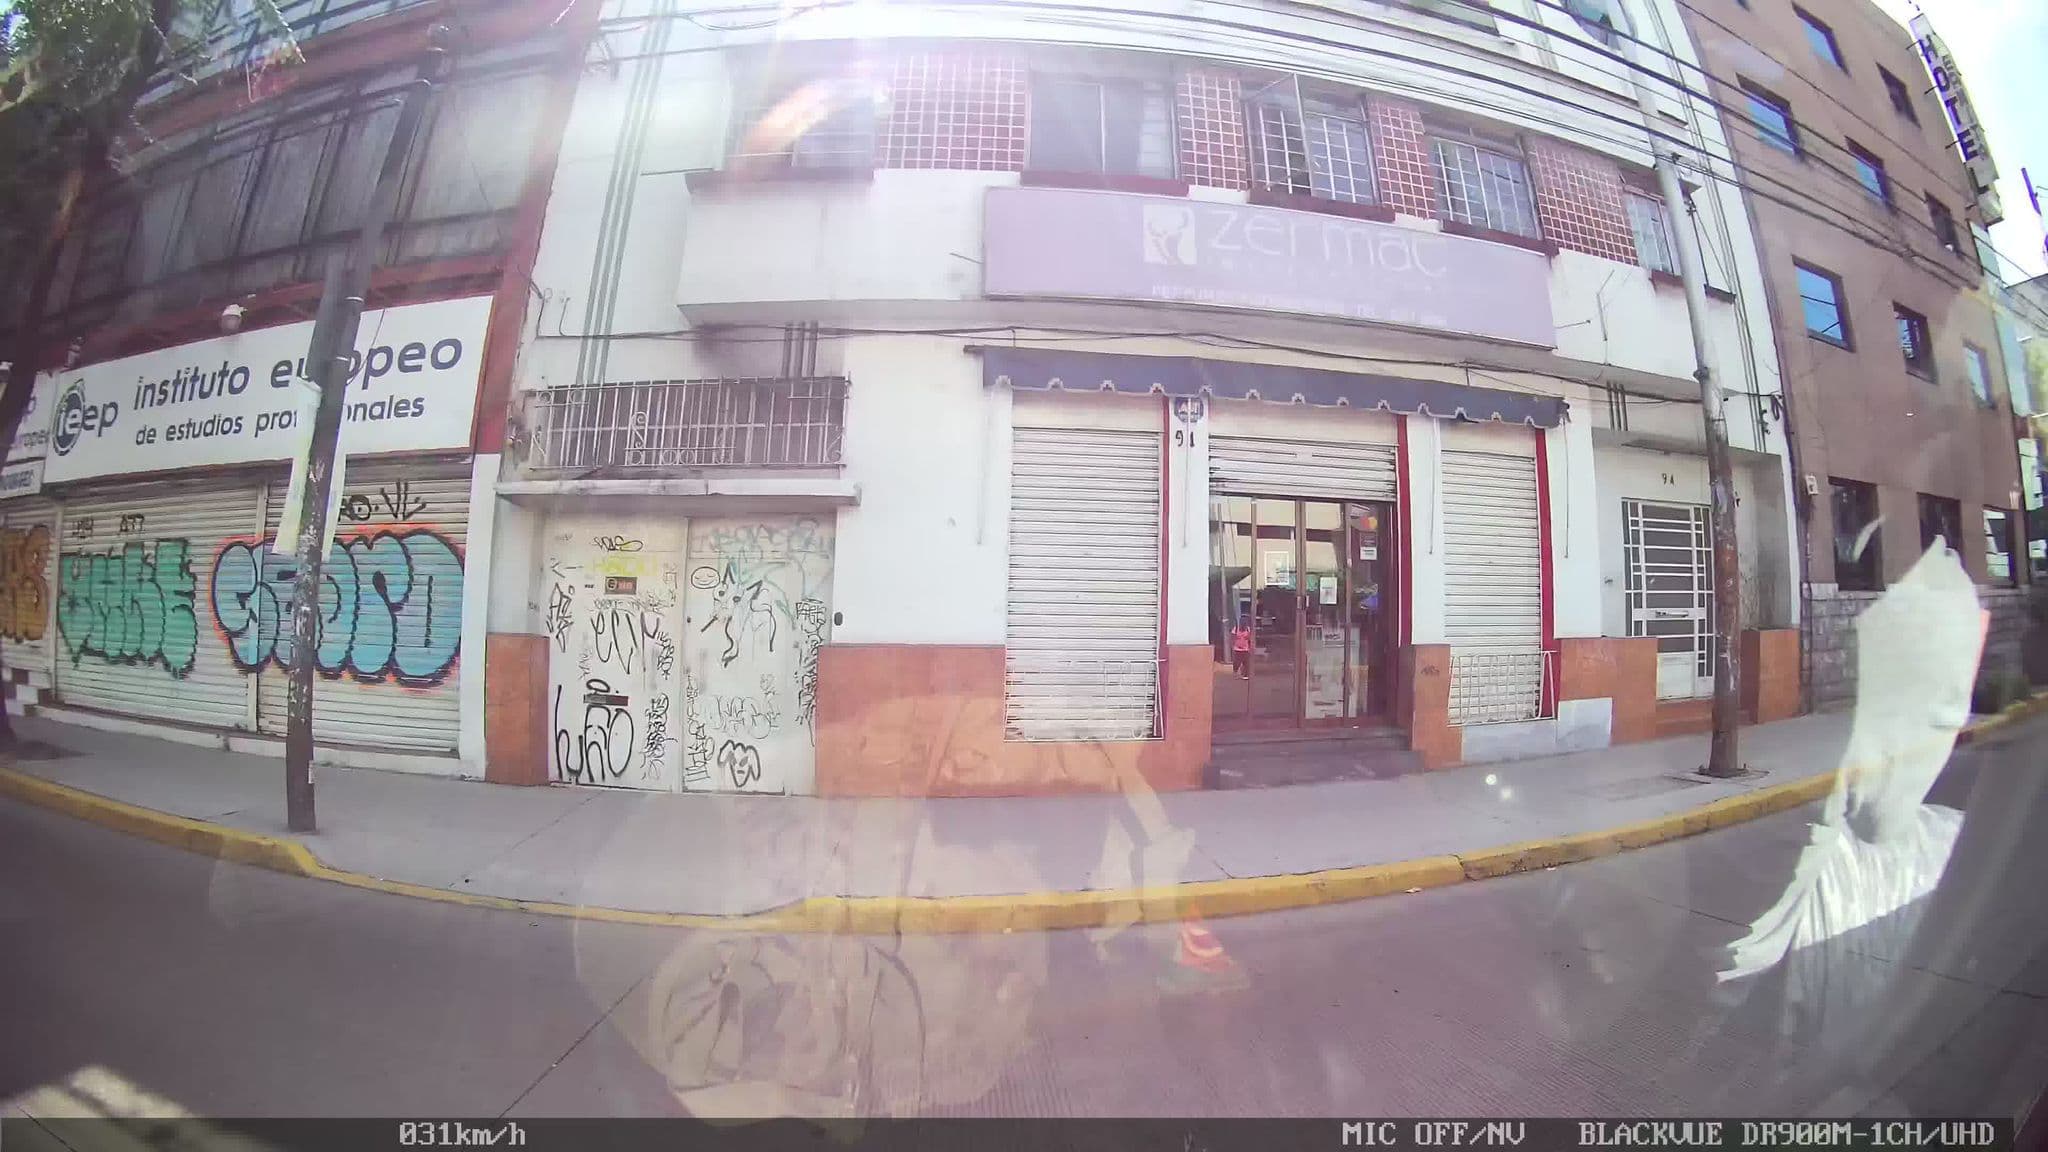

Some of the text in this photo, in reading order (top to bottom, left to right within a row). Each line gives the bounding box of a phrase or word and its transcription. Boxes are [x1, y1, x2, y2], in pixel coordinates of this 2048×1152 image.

[1918, 33, 1989, 194] HOTEL
[133, 360, 250, 410] instituto
[135, 424, 157, 446] de
[165, 413, 244, 442] estudios
